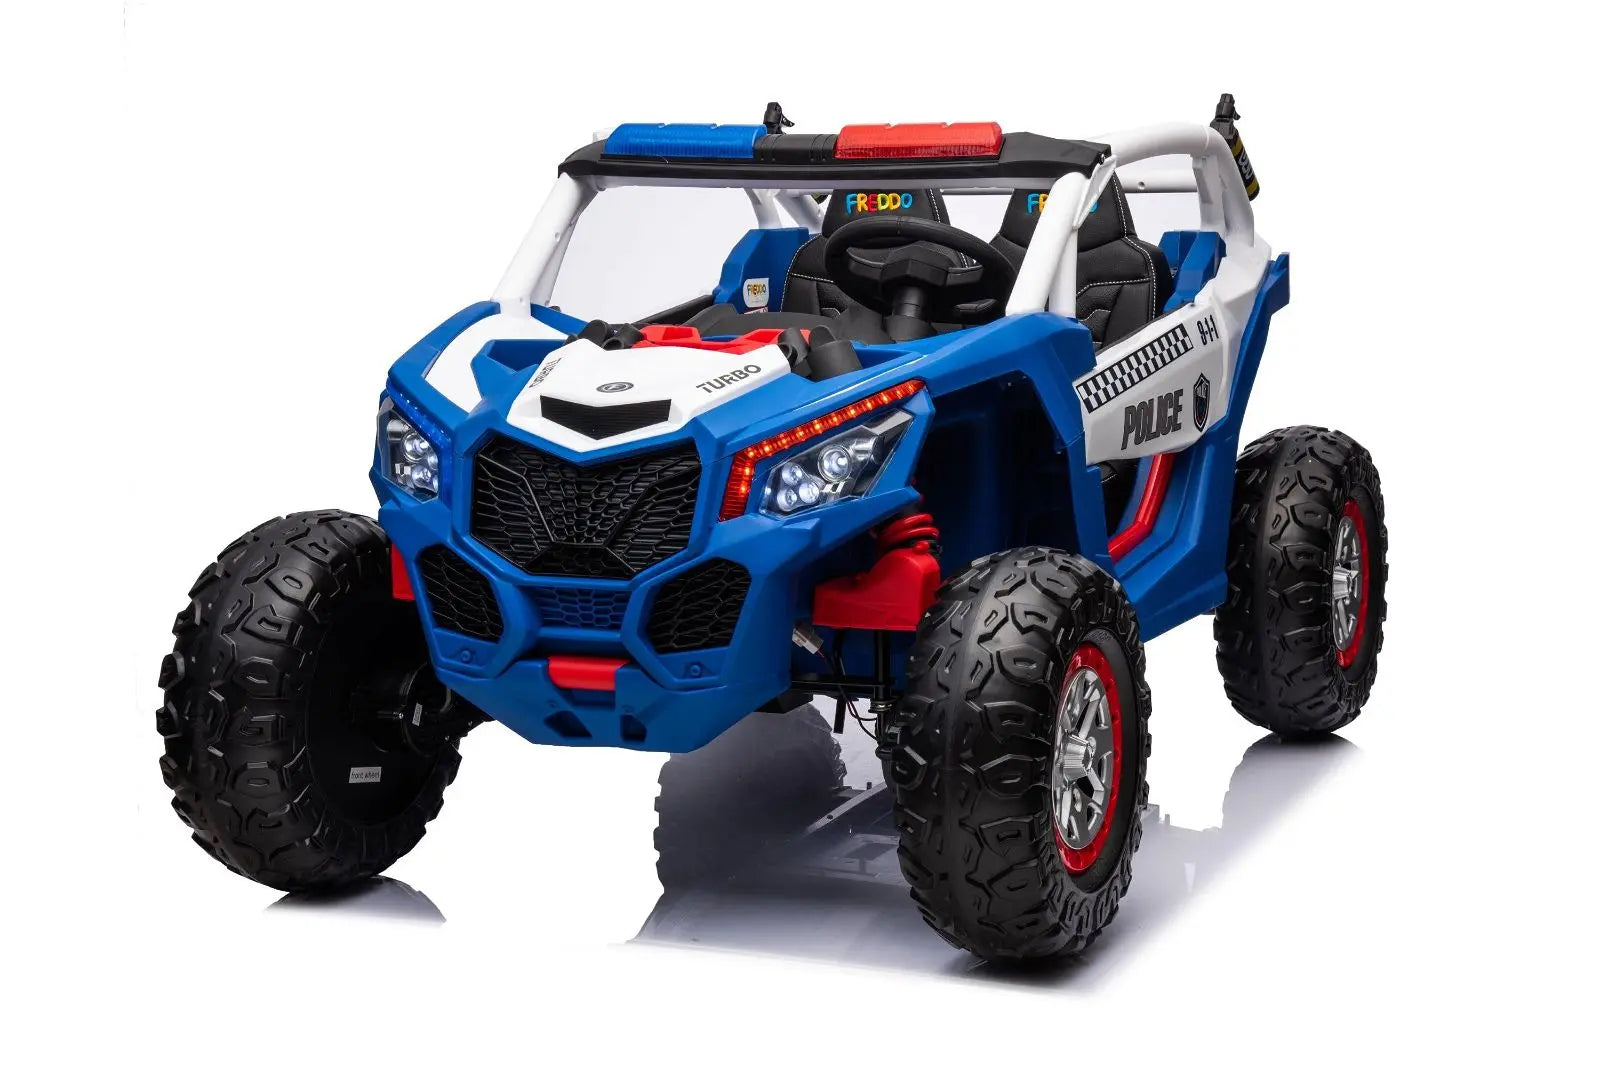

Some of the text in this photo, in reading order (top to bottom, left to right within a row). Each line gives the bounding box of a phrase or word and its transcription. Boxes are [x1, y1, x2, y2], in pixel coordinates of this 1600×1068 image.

[846, 193, 913, 214] FREDDO
[695, 364, 762, 394] TURBO
[1121, 388, 1184, 451] POLICE
